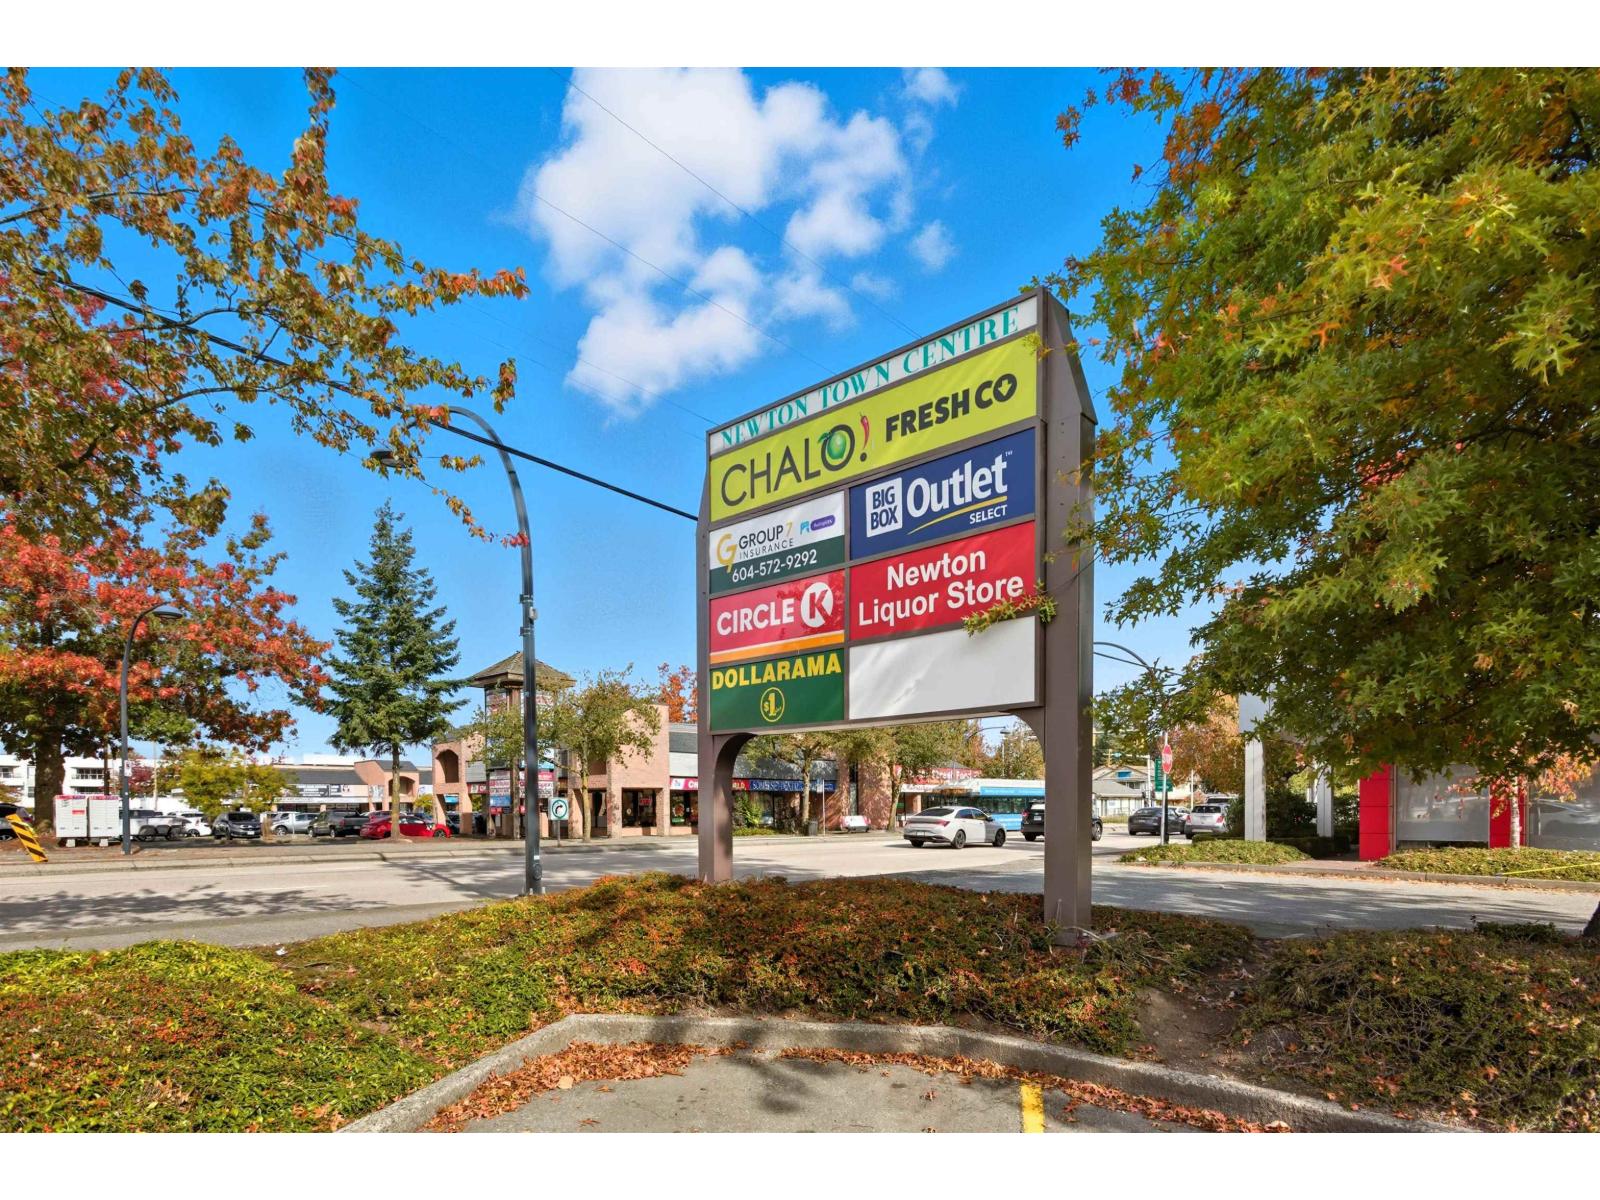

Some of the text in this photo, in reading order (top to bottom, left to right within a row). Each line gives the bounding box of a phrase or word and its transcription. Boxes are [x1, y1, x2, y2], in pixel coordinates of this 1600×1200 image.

[721, 306, 1020, 447] NEWTON TOWN CENTRE
[872, 486, 896, 510] BIG
[906, 454, 1008, 518] Outlet
[870, 507, 898, 531] BOX
[969, 505, 1008, 525] SELECT
[738, 524, 784, 550] GROUP
[786, 522, 793, 538] 7
[739, 538, 794, 560] INSURANCE
[732, 549, 818, 583] 604-572-9292
[887, 550, 986, 591] Newton
[717, 589, 832, 636] CIRCLE K
[858, 575, 1024, 627] Liquor Store
[712, 653, 842, 690] DOLLARAMA
